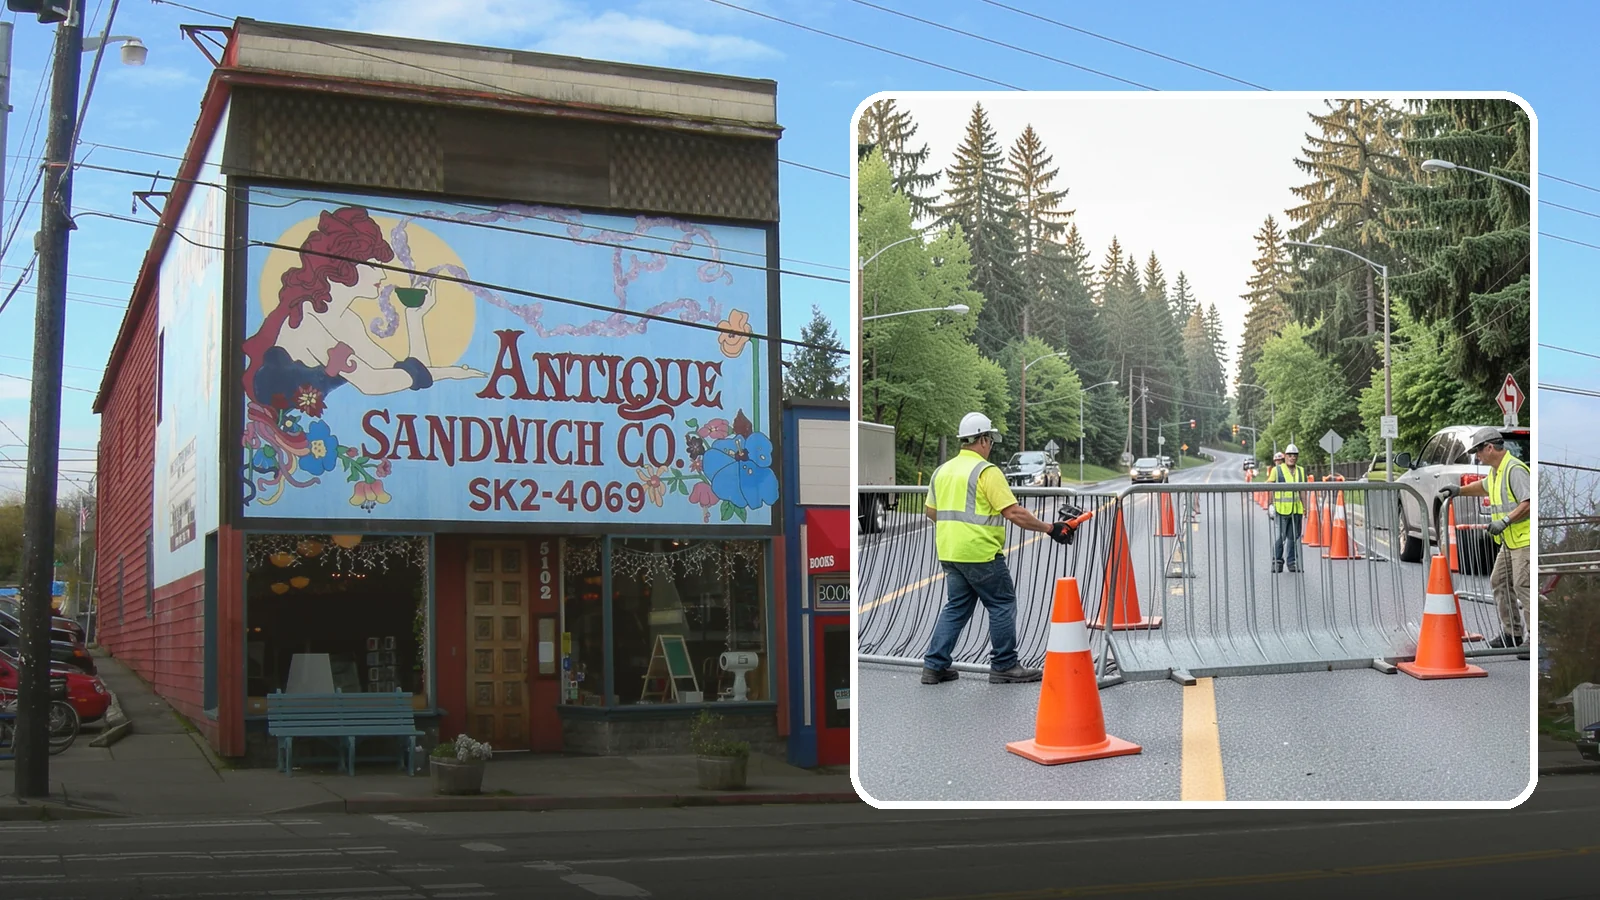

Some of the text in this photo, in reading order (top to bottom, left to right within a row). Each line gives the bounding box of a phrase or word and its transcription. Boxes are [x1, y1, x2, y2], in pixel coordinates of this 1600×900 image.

[476, 329, 724, 421] ANTIQUE
[361, 408, 686, 470] SANDWICH CO.
[468, 477, 646, 514] SK2-4069
[540, 542, 551, 599] 5102
[809, 555, 835, 569] BOOKS
